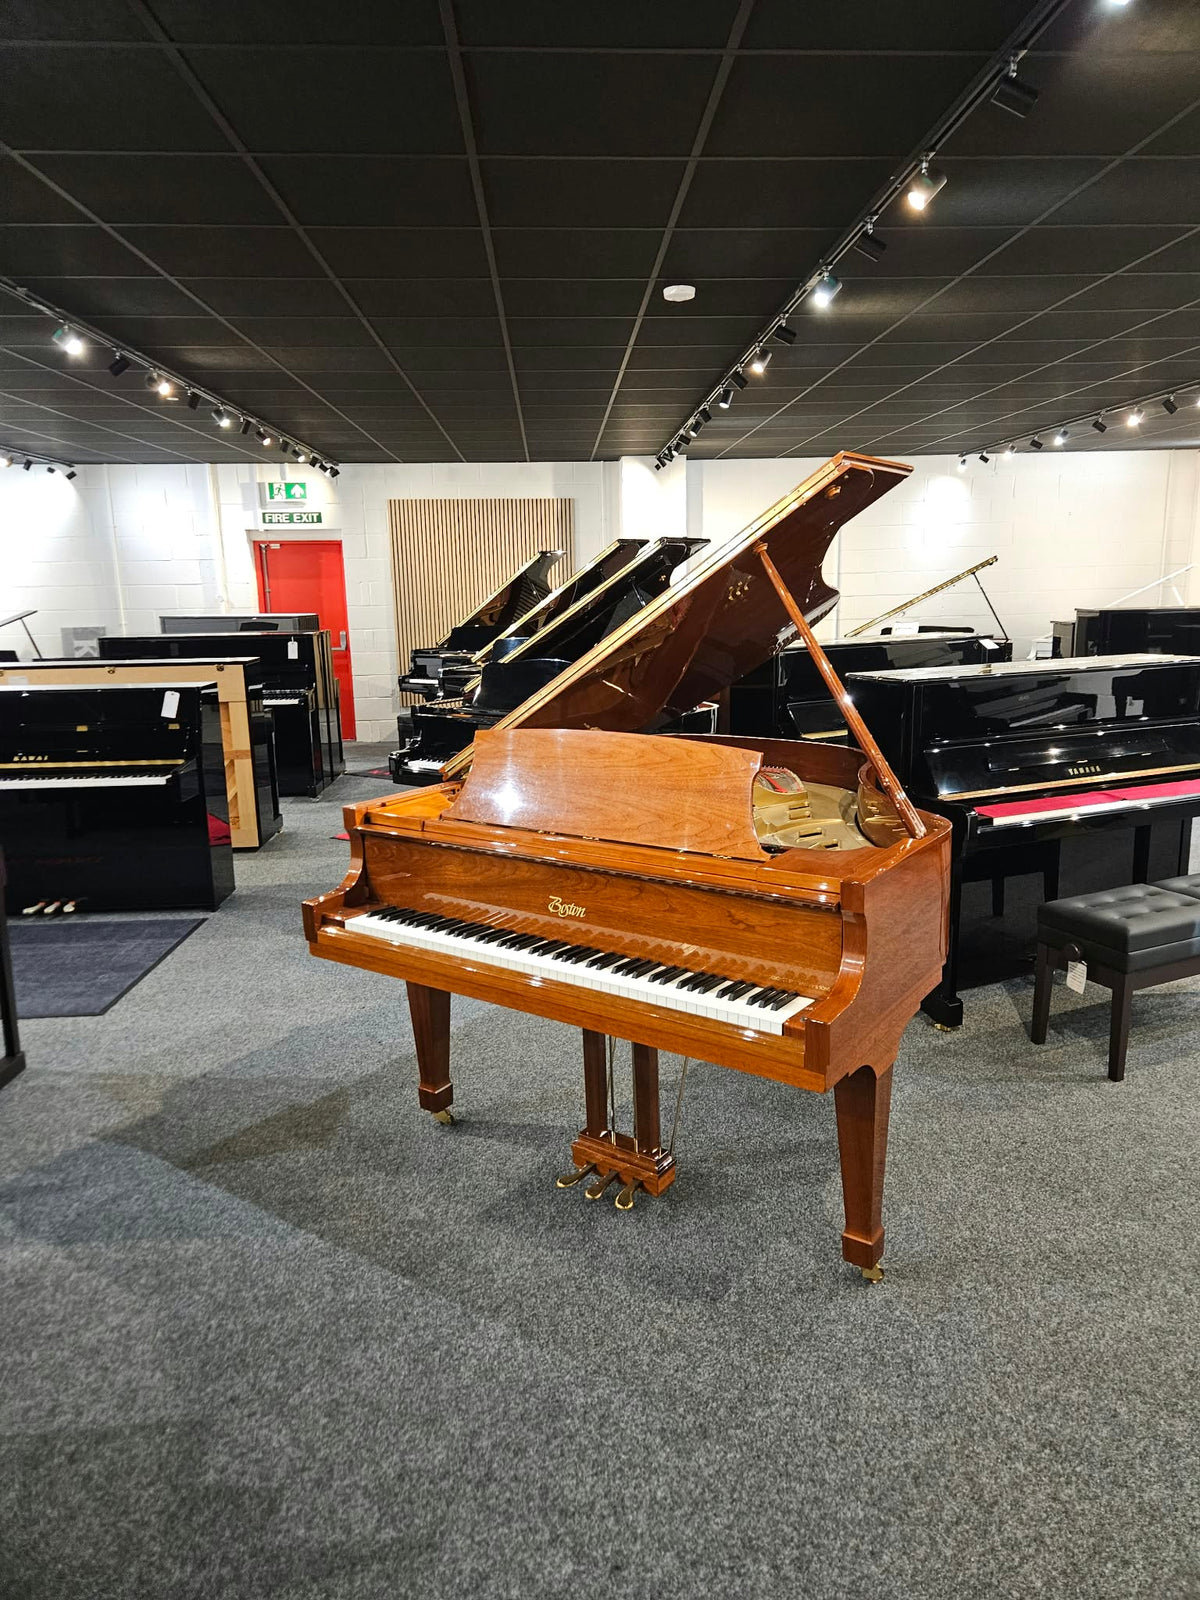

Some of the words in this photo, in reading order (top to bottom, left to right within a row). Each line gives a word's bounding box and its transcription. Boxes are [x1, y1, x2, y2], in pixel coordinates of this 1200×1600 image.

[264, 513, 290, 523] FIRE
[292, 513, 319, 523] EXIT
[1067, 765, 1101, 776] YAMAHA
[548, 895, 586, 918] Boston
